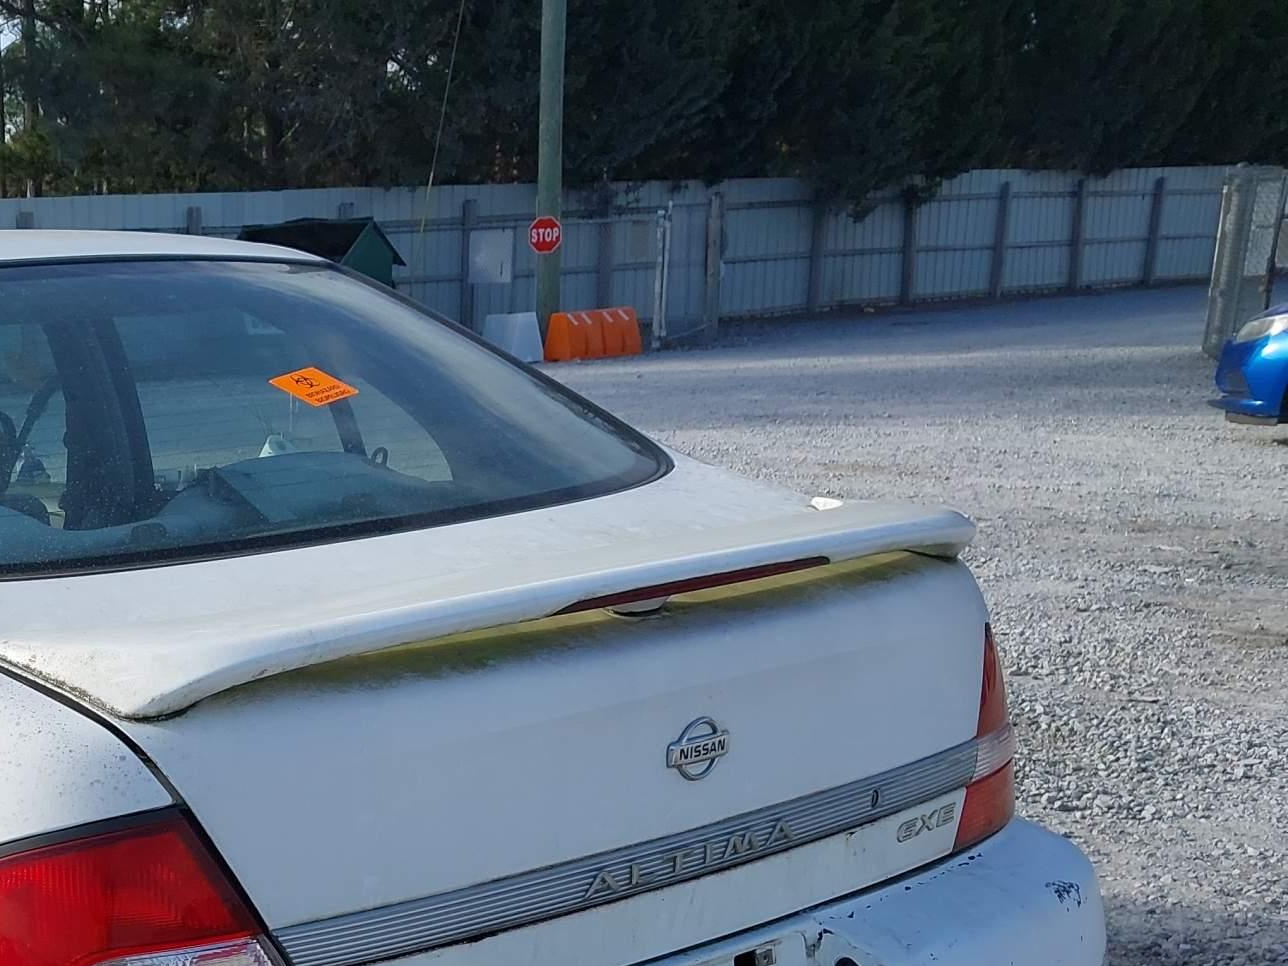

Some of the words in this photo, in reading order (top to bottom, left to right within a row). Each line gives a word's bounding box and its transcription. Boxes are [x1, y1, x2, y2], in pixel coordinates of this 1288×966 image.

[531, 227, 560, 243] STOP
[679, 737, 726, 761] NISSAN
[896, 802, 957, 843] GXE
[583, 819, 795, 900] ALTIMA
